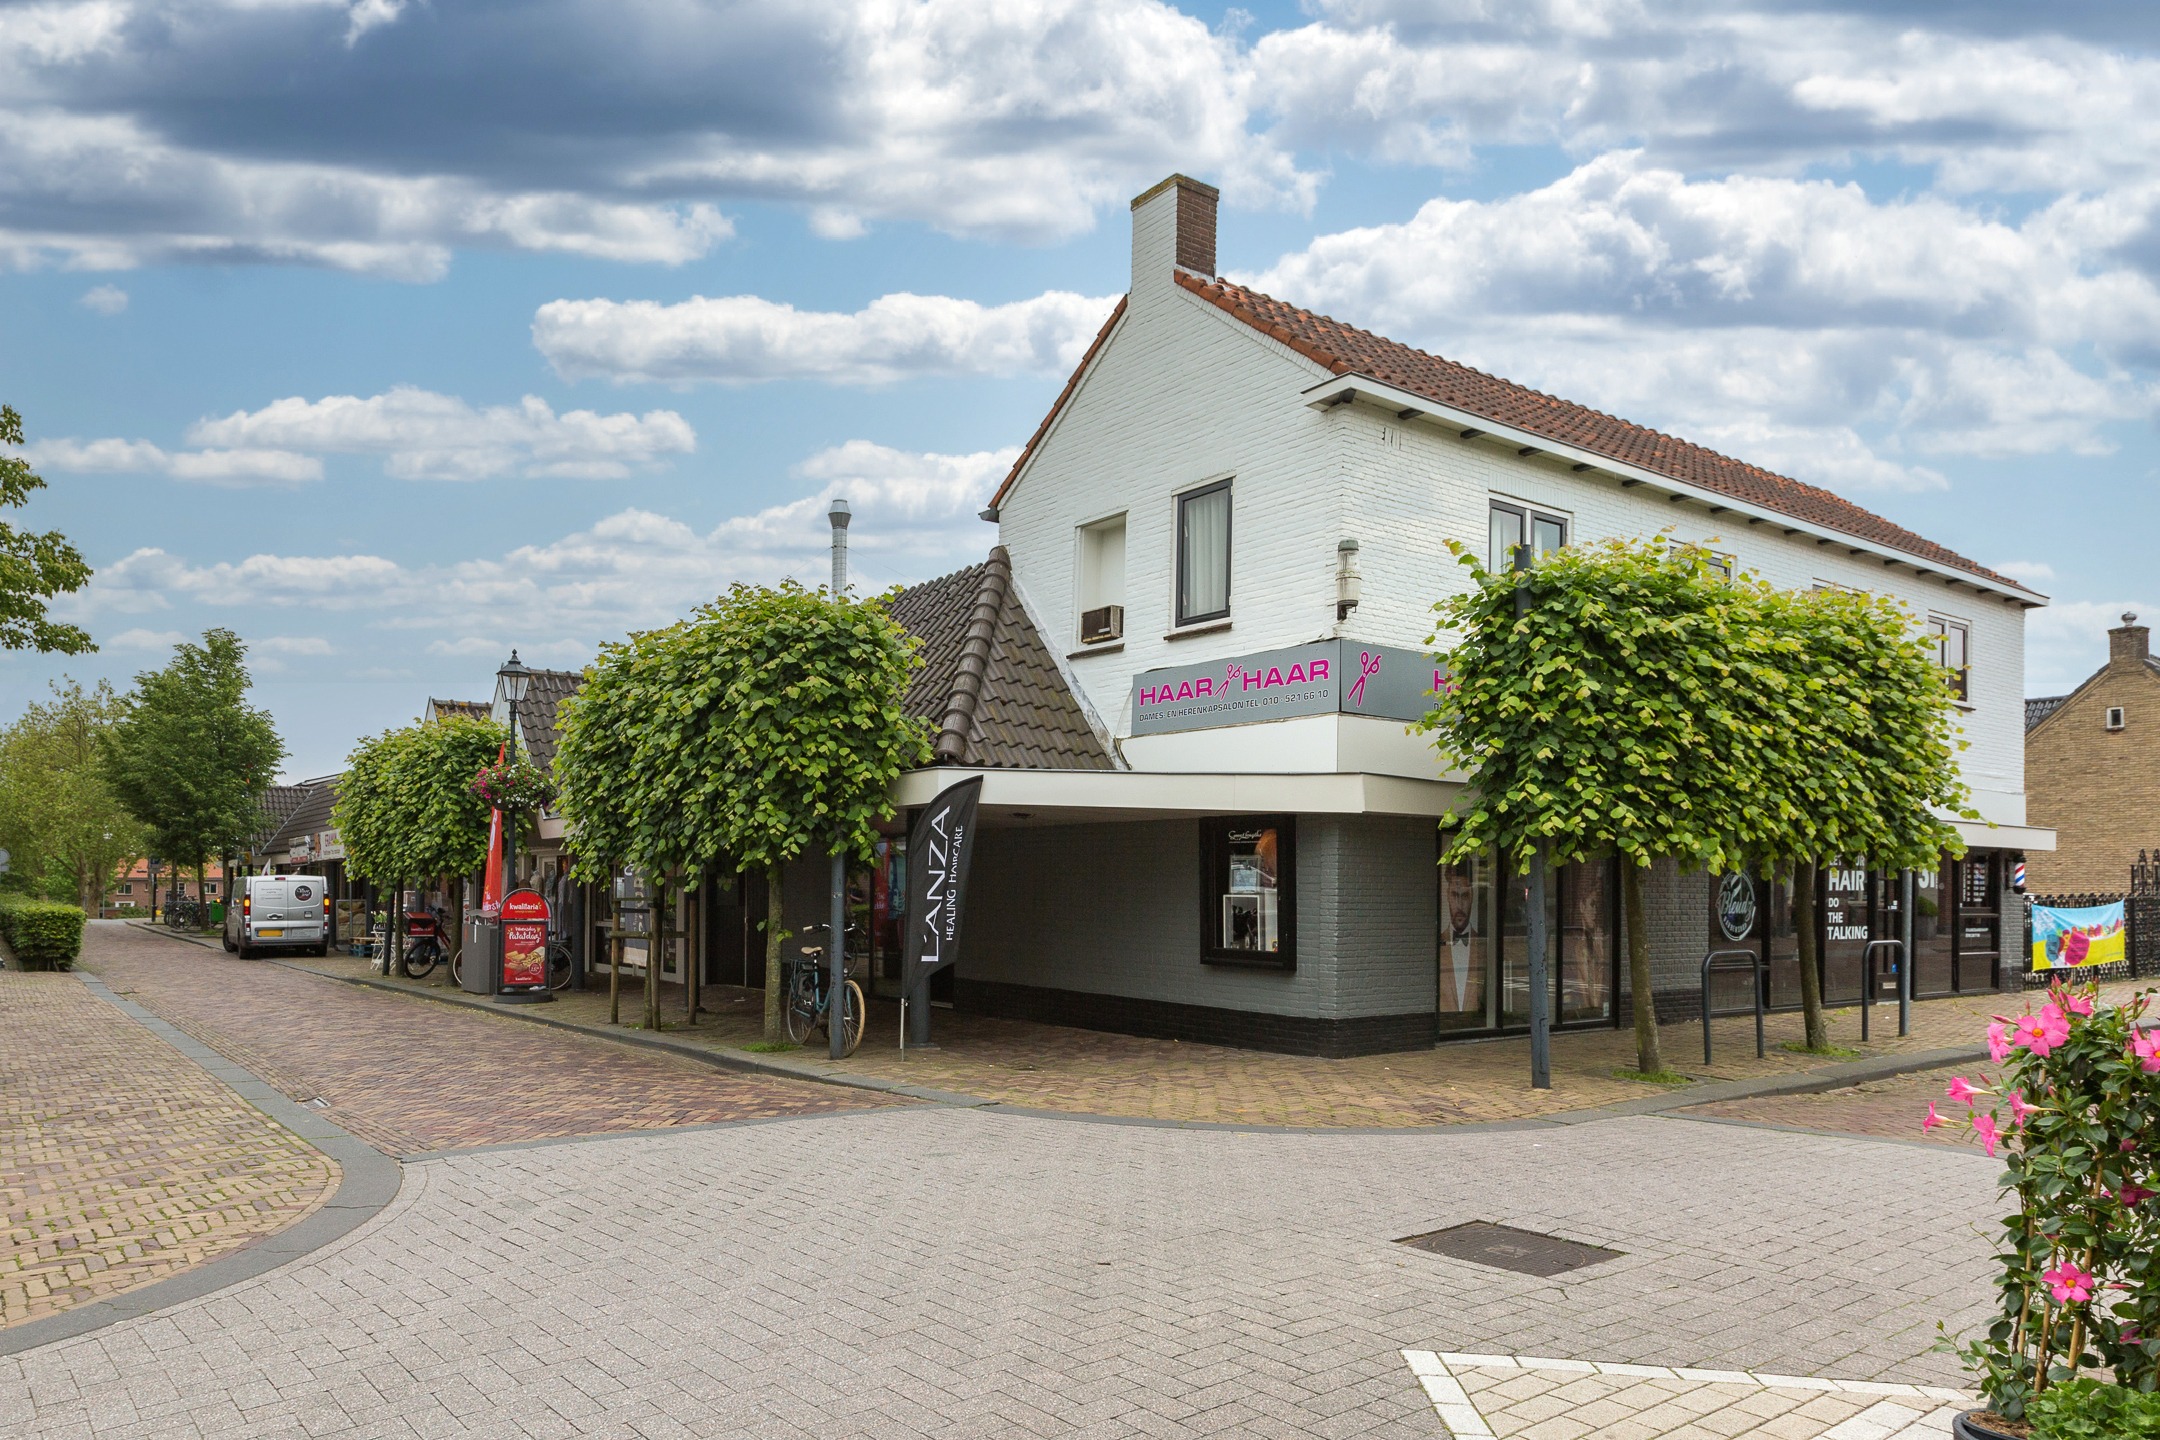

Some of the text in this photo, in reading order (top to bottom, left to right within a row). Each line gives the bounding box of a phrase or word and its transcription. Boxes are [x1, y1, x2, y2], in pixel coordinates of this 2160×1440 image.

[1139, 659, 1330, 706] HAAR HAAR
[1167, 710, 1177, 718] EN
[1178, 701, 1244, 717] HERENKAPSALON
[1304, 691, 1315, 700] 66
[1317, 689, 1329, 698] 10
[946, 825, 963, 941] HEALING HAIRCARE
[1828, 870, 1865, 891] HAIR
[1828, 897, 1839, 908] DO
[1827, 911, 1843, 923] THE
[1827, 926, 1868, 940] TALKING
